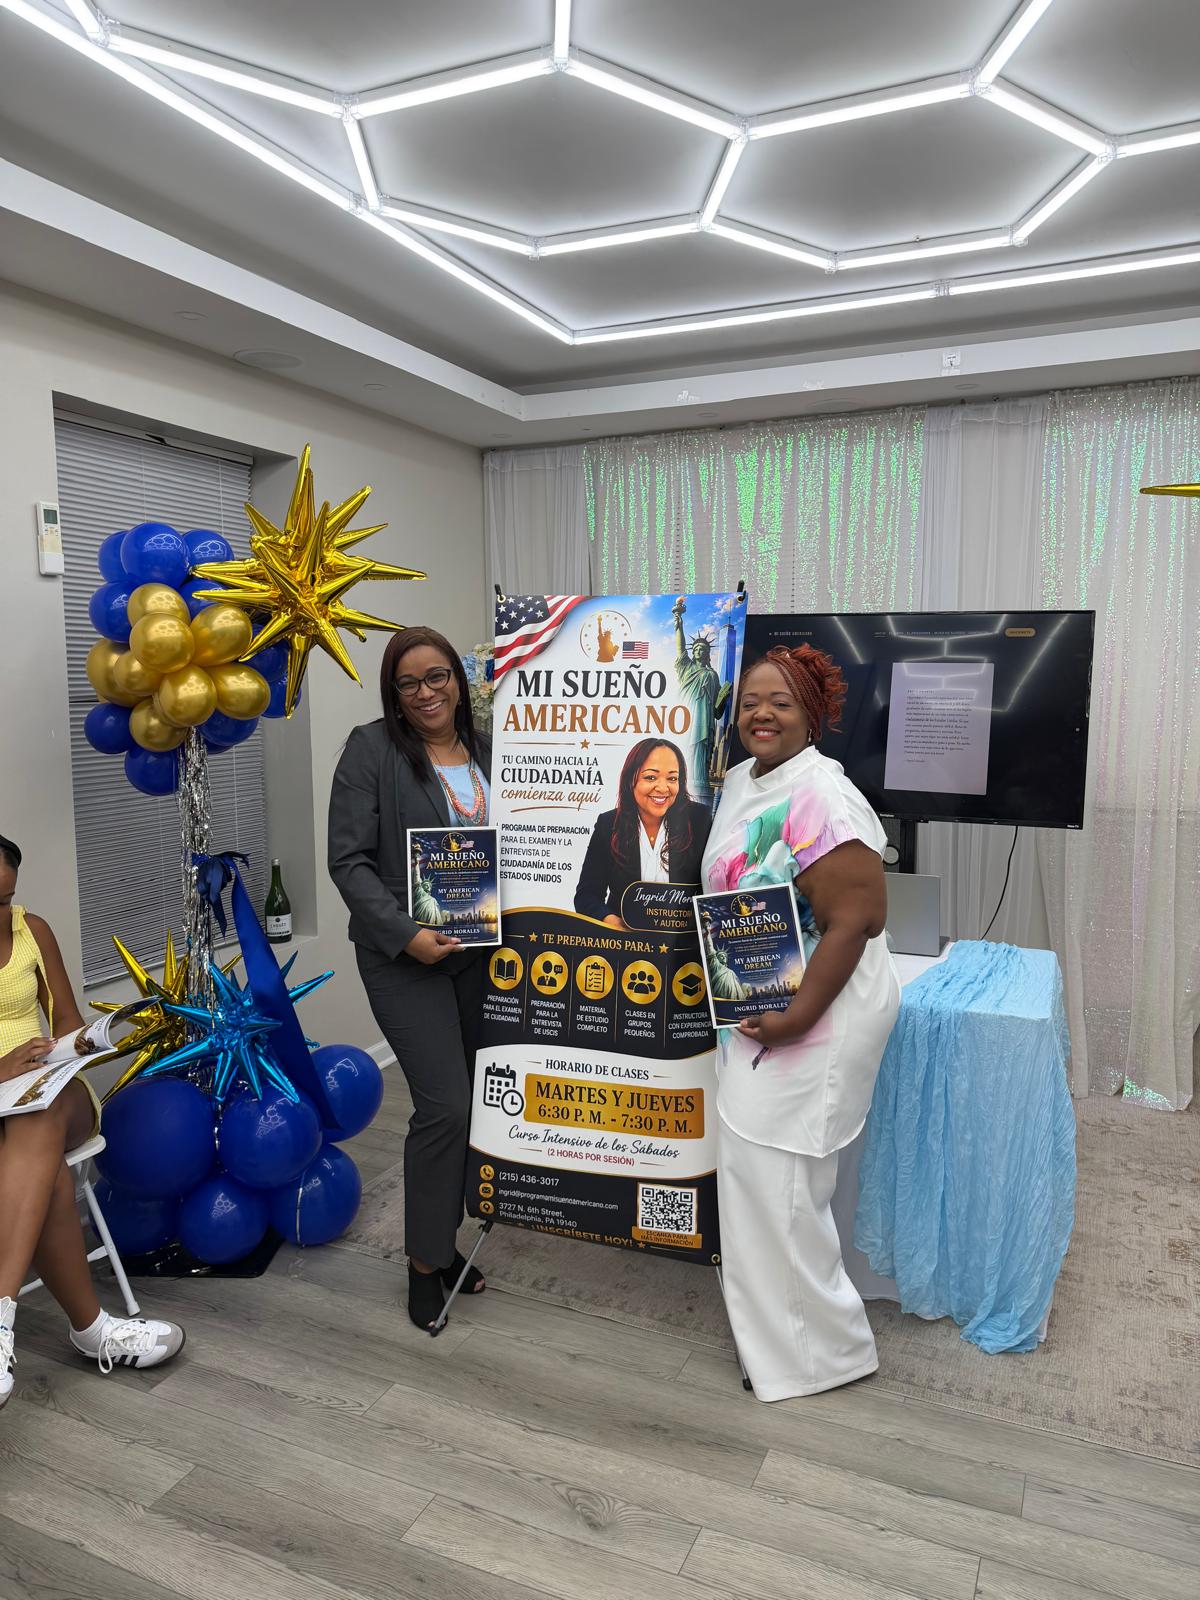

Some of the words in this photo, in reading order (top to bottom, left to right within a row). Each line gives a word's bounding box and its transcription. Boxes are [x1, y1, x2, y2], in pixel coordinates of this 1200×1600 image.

[516, 670, 553, 698] MI
[562, 664, 667, 699] SUEÑO
[503, 704, 691, 734] AMERICANO
[502, 755, 514, 765] TU
[516, 755, 552, 765] CAMINO
[554, 756, 584, 766] HACIA
[586, 756, 598, 766] LA
[501, 766, 604, 786] CIUDADANÍA
[501, 786, 565, 801] comienza
[568, 788, 602, 812] aquí
[502, 824, 536, 833] PROGRAMA
[538, 825, 546, 833] DE
[547, 825, 590, 835] PREPARACIÓN
[501, 836, 518, 844] PARA
[528, 837, 556, 845] EXAMEN
[563, 838, 572, 846] LA
[430, 852, 444, 861] MI
[447, 850, 485, 860] SUEÑO
[500, 848, 540, 857] ENTREVISTA
[426, 860, 490, 869] AMERICANO
[500, 859, 545, 869] CIUDADANÍA
[558, 862, 572, 870] LOS
[500, 871, 532, 881] ESTADOS
[533, 873, 562, 883] UNIDOS
[634, 887, 667, 906] Ingrid
[721, 919, 736, 929] MI
[738, 912, 780, 927] SUEÑO
[719, 922, 788, 938] AMERICANO
[542, 933, 554, 944] TE
[557, 934, 622, 950] PREPARAMOS
[624, 939, 654, 952] PARA:
[746, 954, 781, 964] AMERICAN
[744, 962, 772, 970] DREAM
[487, 994, 519, 1004] PREPARACIÓN
[501, 1006, 522, 1014] EXAMEN
[530, 1000, 565, 1010] PREPARACIÓN
[580, 1005, 606, 1014] MATERIAL
[490, 1014, 520, 1024] CIUDADANÍA
[584, 1015, 609, 1024] ESTUDIO
[625, 1010, 647, 1018] CLASES
[673, 1012, 708, 1020] INSTRUCTORA
[531, 1018, 562, 1028] ENTREVISTA
[576, 1024, 608, 1033] COMPLETO
[628, 1020, 652, 1028] GRUPOS
[542, 1028, 559, 1037] USCIS
[624, 1029, 656, 1038] PEQUEÑOS
[672, 1030, 709, 1039] COMPROBADA
[545, 1058, 592, 1074] HORARIO
[595, 1064, 609, 1075] DE
[611, 1066, 650, 1080] CLASES
[535, 1081, 607, 1106] MARTES
[611, 1091, 624, 1107] Y
[627, 1091, 695, 1113] JUEVES
[538, 1104, 570, 1120] 6:30
[574, 1108, 585, 1122] P.
[589, 1110, 606, 1125] M.
[622, 1114, 653, 1131] 7:30
[657, 1118, 669, 1132] P.
[674, 1119, 693, 1133] M.
[508, 1125, 540, 1142] Curso
[541, 1128, 592, 1148] Intensivo
[594, 1136, 609, 1150] de
[612, 1138, 628, 1152] los
[630, 1140, 680, 1158] Sábados
[547, 1148, 555, 1157] (2
[556, 1148, 584, 1160] HORAS
[585, 1151, 601, 1162] POR
[603, 1152, 635, 1166] SESIÓN)
[499, 1172, 518, 1182] (215)
[520, 1175, 560, 1186] 436-3017
[499, 1202, 516, 1210] 3727
[541, 1208, 565, 1218] Street,
[499, 1210, 544, 1223] Philadelphia,
[556, 1219, 577, 1228] 19140
[604, 1236, 633, 1248] HOY!
[654, 1237, 693, 1246] INFORMACIÓN
